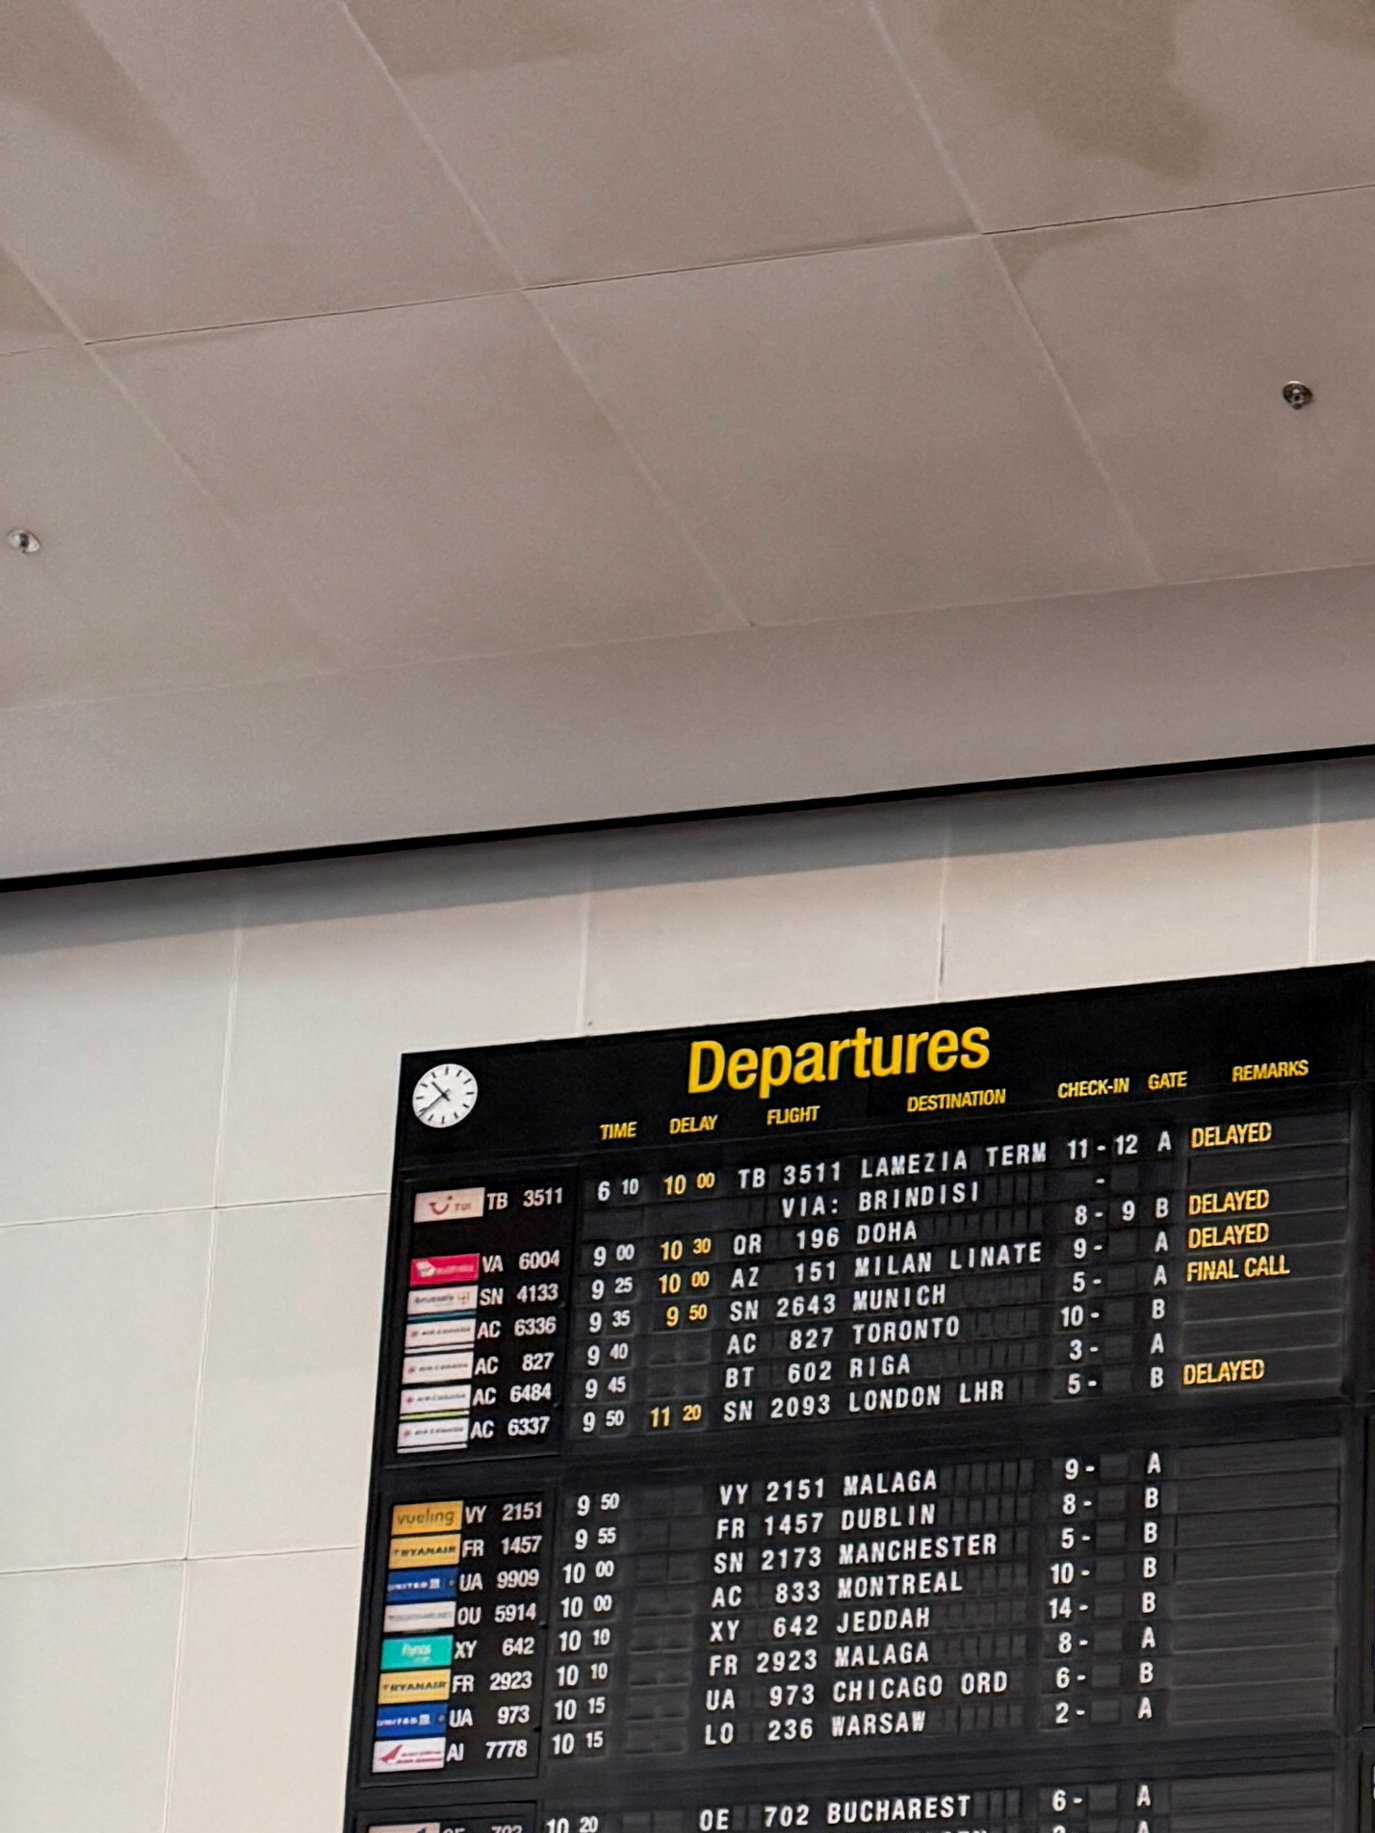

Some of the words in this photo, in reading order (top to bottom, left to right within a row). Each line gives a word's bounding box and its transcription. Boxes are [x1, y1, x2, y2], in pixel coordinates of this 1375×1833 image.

[689, 1027, 989, 1098] Departures
[601, 1122, 635, 1139] TIME
[670, 1116, 717, 1133] DELAY
[768, 1106, 819, 1124] FLIGHT
[908, 1089, 1005, 1111] DESTINATION
[1058, 1078, 1129, 1098] CHECK-IN
[1149, 1072, 1186, 1089] GATE
[1233, 1060, 1308, 1081] REMARKS
[862, 1151, 966, 1177] LAMEZIA
[987, 1143, 1045, 1166] TERM
[1192, 1122, 1271, 1148] DELAYED
[860, 1182, 977, 1211] BRINDISI
[857, 1221, 916, 1244] DOHA
[1189, 1190, 1269, 1215] DELAYED
[855, 1253, 931, 1276] MILAN
[951, 1242, 1040, 1269] LINATE
[854, 1284, 945, 1310] MUNICH
[1187, 1258, 1239, 1281] FINAL
[1244, 1254, 1290, 1278] CALL
[853, 1316, 959, 1344] TORONTO
[850, 1354, 909, 1378] RIGA
[850, 1385, 940, 1411] LONDON
[960, 1380, 1003, 1403] LHR
[1184, 1359, 1264, 1384] DELAYED
[844, 1470, 936, 1495] MALAGA
[842, 1504, 934, 1530] DUBLIN
[840, 1534, 996, 1564] MANCHESTER
[838, 1571, 962, 1598] MONTREAL
[837, 1607, 929, 1633] JEDDAH
[834, 1675, 942, 1702] CHICAGO
[962, 1671, 1006, 1694] ORD
[832, 1711, 925, 1736] WARSAW
[828, 1795, 970, 1823] BUCHAREST
